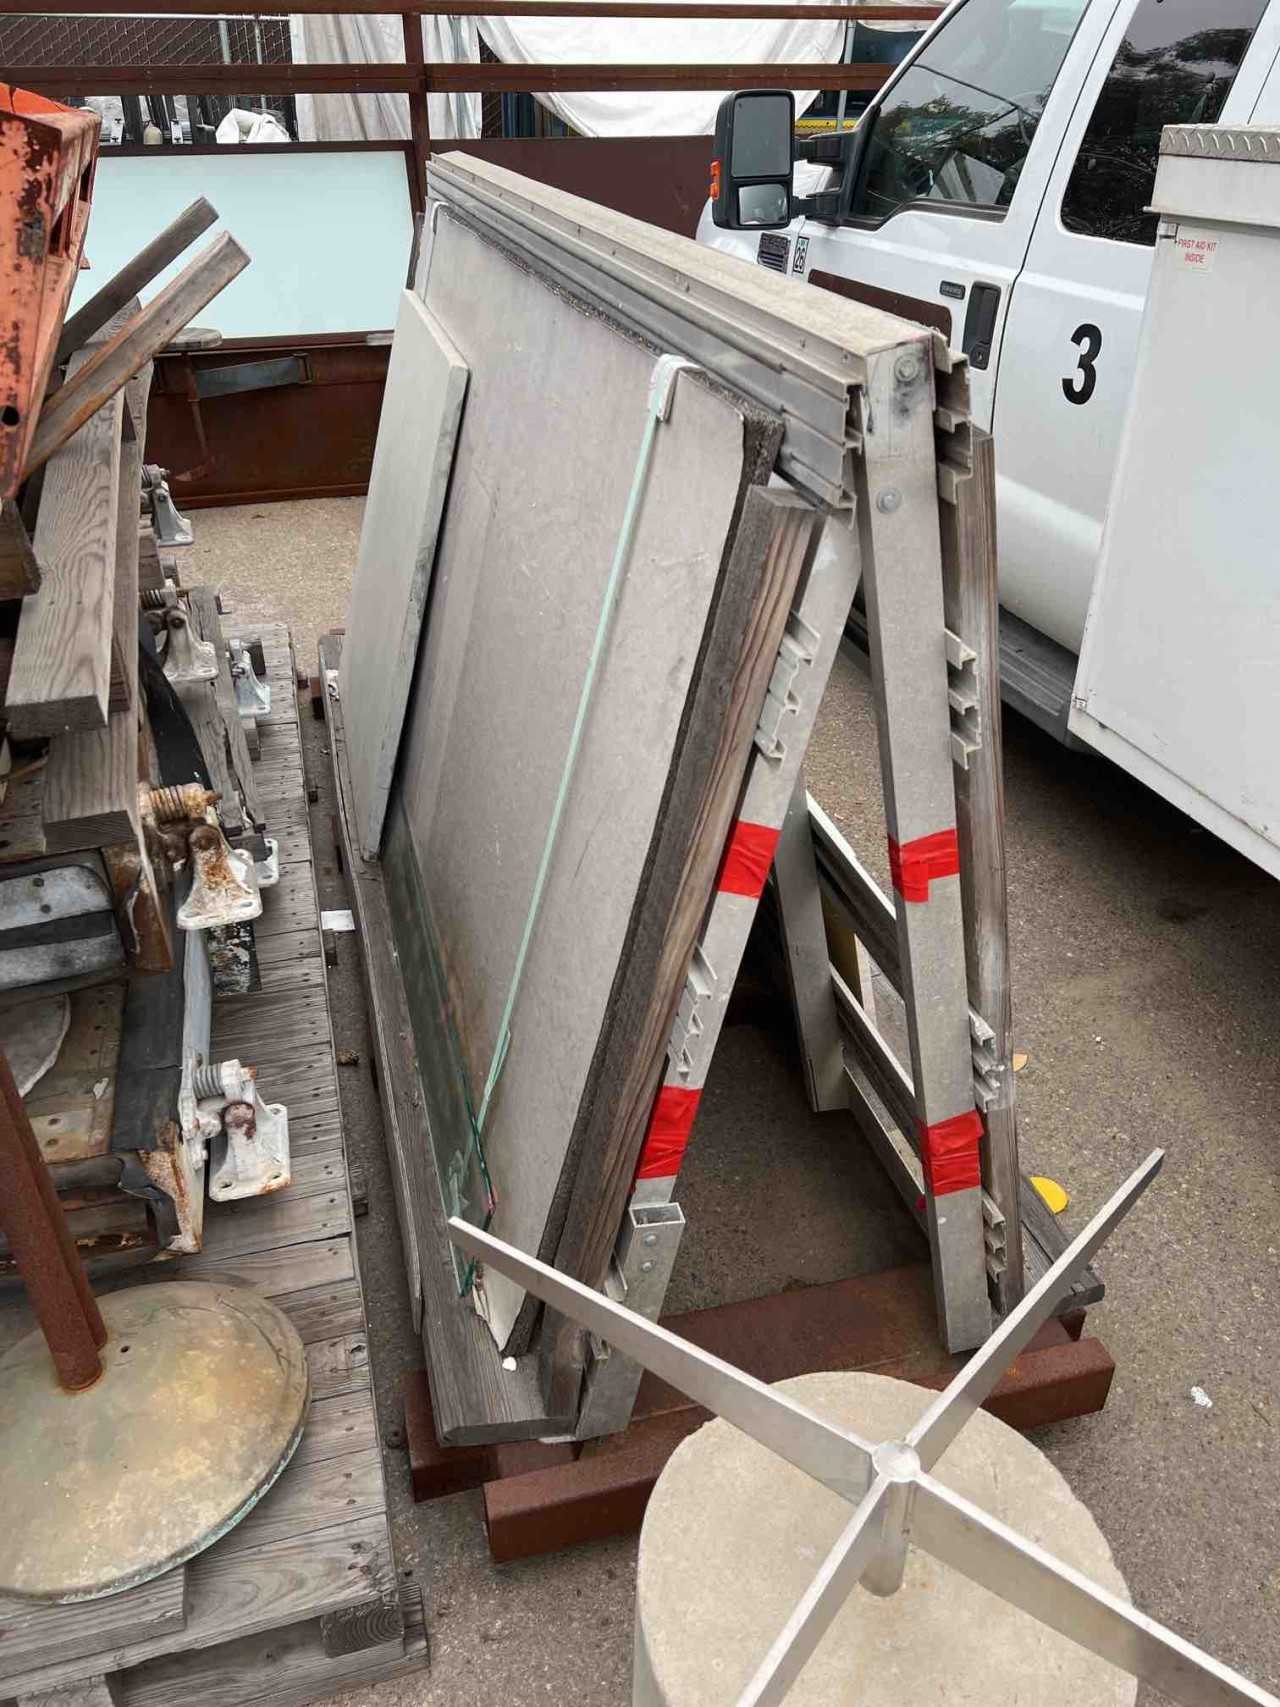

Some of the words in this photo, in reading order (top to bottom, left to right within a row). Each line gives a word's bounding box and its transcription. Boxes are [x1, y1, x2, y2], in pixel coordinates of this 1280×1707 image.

[1178, 239, 1195, 249] FIRST
[1195, 241, 1206, 250] AID
[1207, 242, 1217, 252] KIT
[1185, 253, 1205, 264] INSIDE
[1062, 323, 1102, 405] 3
